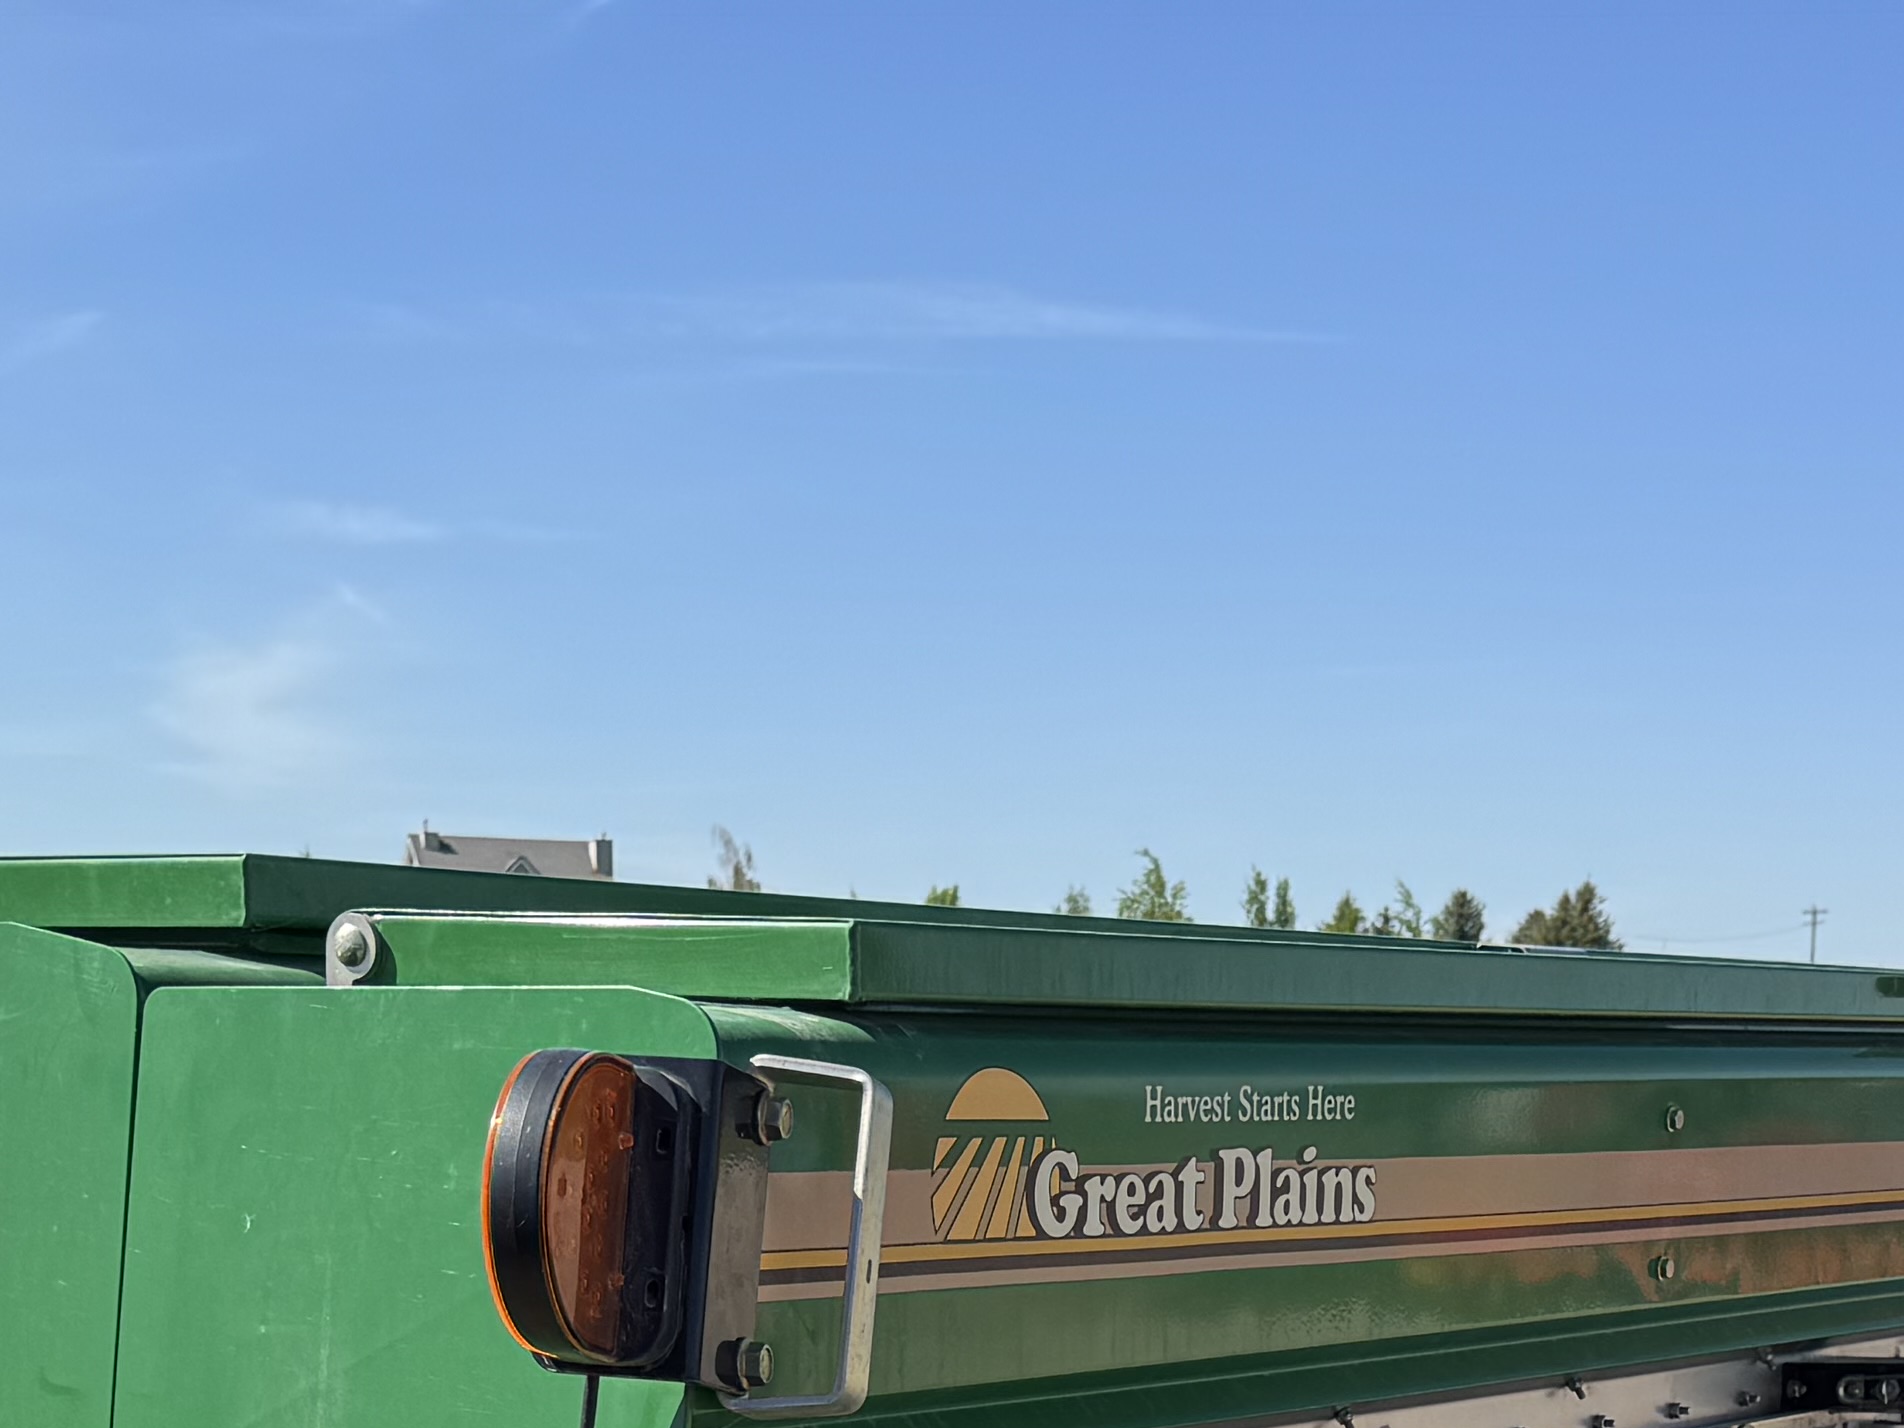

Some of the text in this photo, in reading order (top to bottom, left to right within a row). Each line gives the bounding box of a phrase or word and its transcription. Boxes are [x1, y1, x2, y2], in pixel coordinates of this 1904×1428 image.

[1144, 1085, 1356, 1124] Harvest Starts Here
[1033, 1146, 1377, 1238] Great Plains
